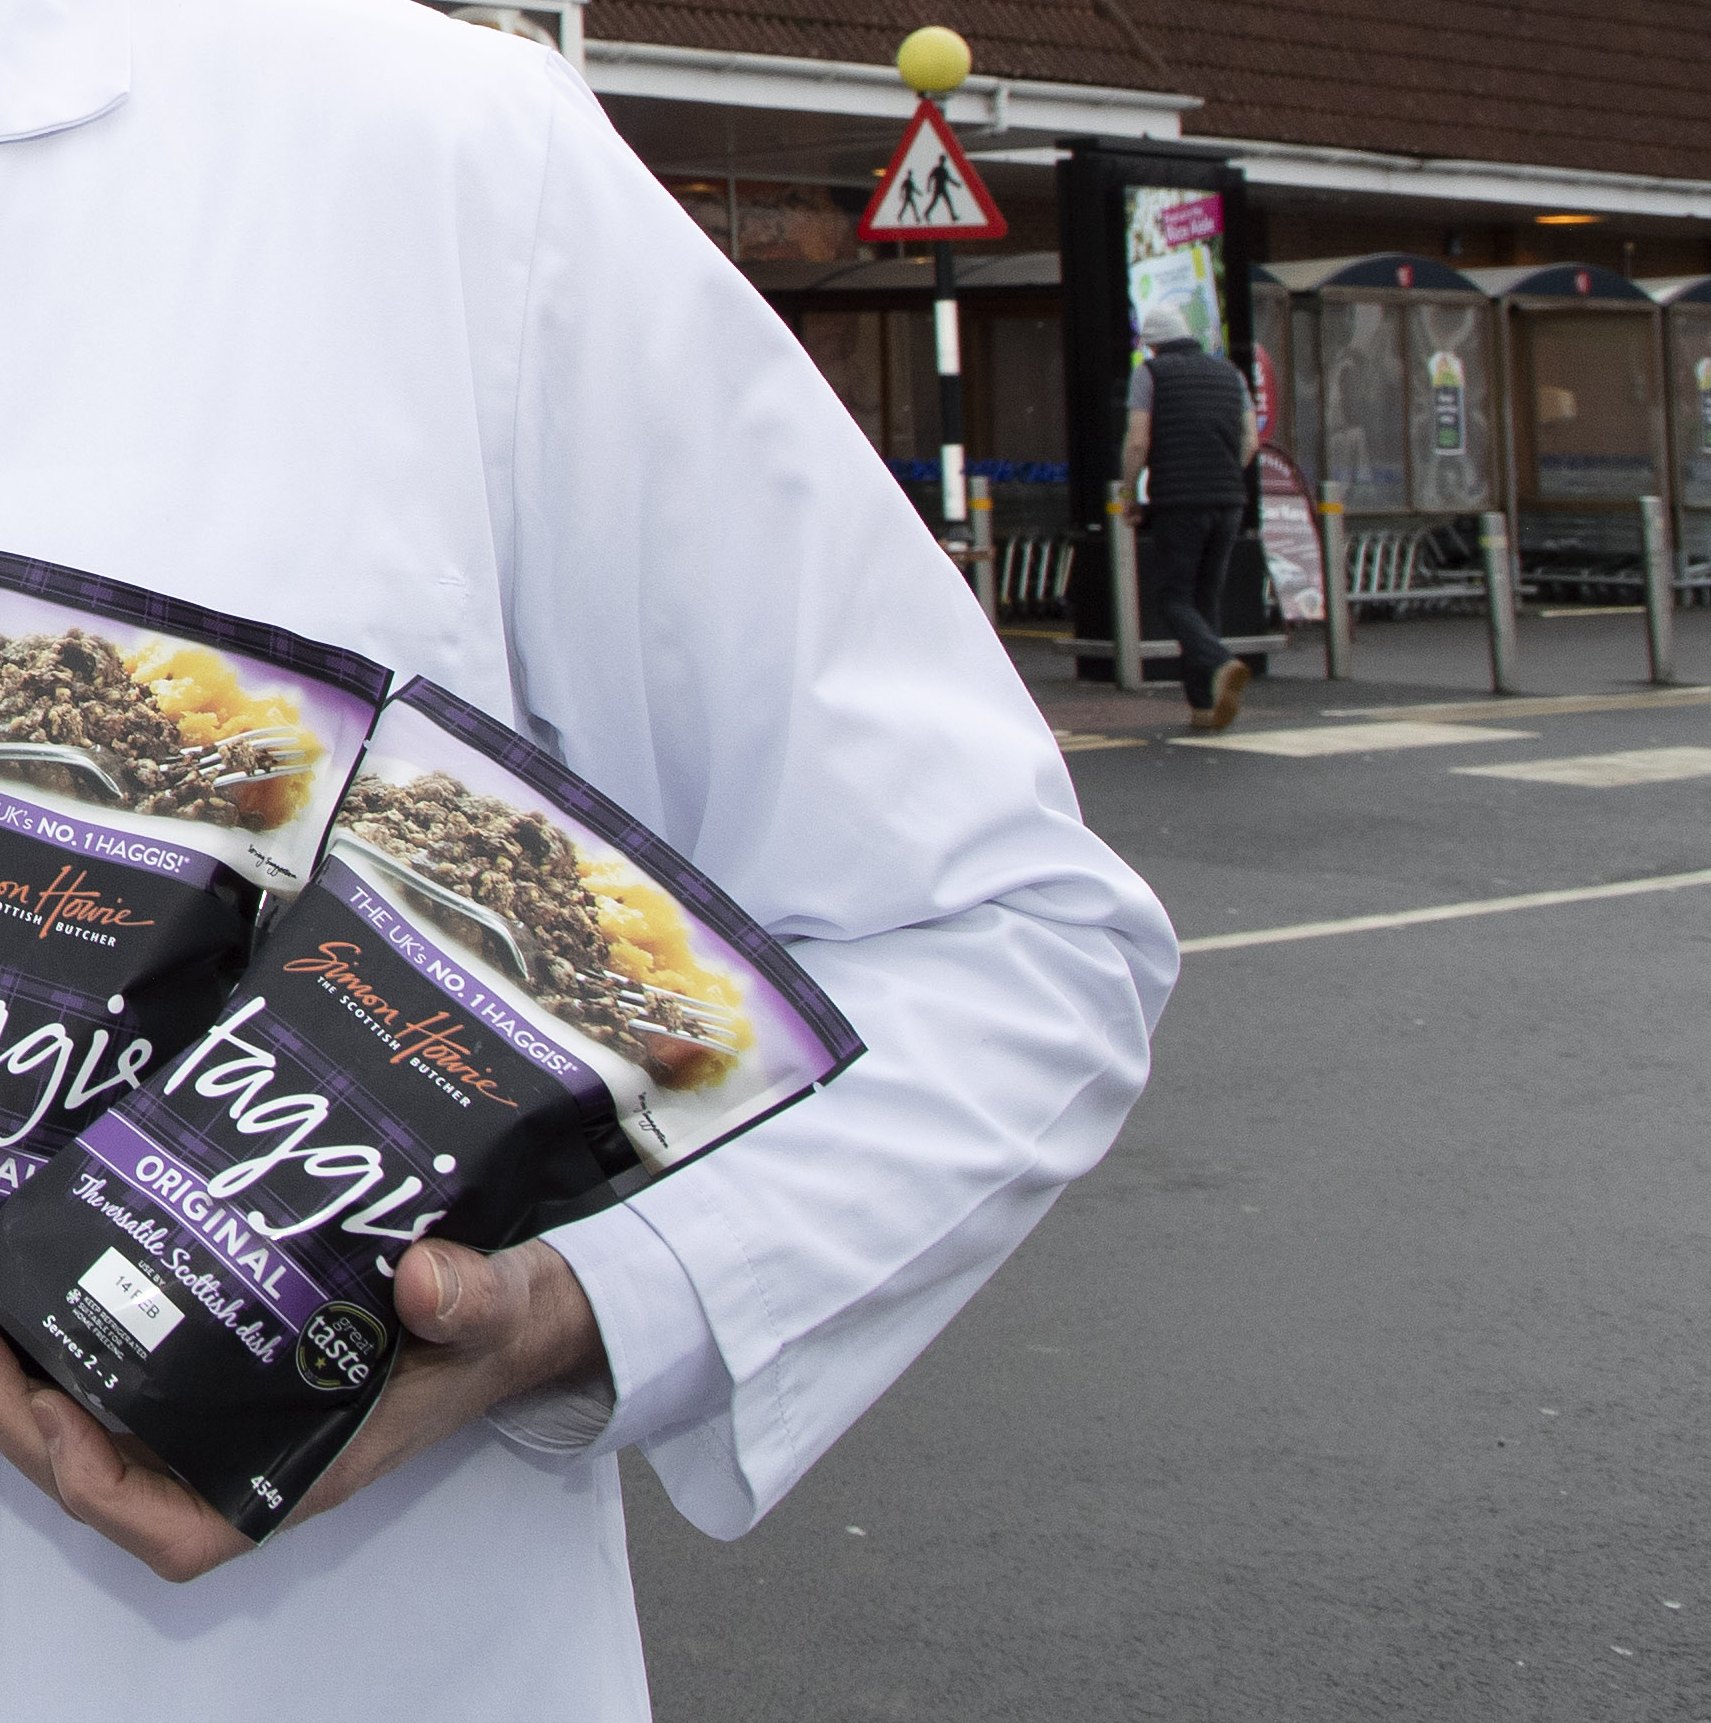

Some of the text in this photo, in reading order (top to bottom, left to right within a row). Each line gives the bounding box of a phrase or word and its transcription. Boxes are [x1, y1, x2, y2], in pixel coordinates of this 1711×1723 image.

[37, 816, 77, 847] NO.
[84, 832, 93, 849] 1
[33, 865, 155, 939] Howie
[55, 921, 117, 948] BUTCHER
[348, 886, 393, 929] THE
[388, 924, 427, 965] UK's
[427, 959, 465, 998] NO.
[470, 993, 484, 1009] 1
[282, 941, 519, 1108] Simon Howie
[317, 976, 472, 1108] THE SCOTTISH BUTCHER
[135, 1154, 284, 1301] ORIGINAL
[72, 1172, 283, 1365] The versatile Scottish dish
[138, 1260, 166, 1289] USE BY
[72, 1308, 92, 1330] HOME
[83, 1296, 102, 1314] KEEP
[115, 1275, 160, 1319] 14 FEB
[78, 1302, 123, 1347] SUITABLE FOR
[333, 1316, 375, 1356] great
[42, 1314, 87, 1359] Serves
[84, 1353, 98, 1370] 2
[104, 1373, 119, 1390] 3
[308, 1316, 369, 1384] taste
[251, 1475, 283, 1509] 454g
